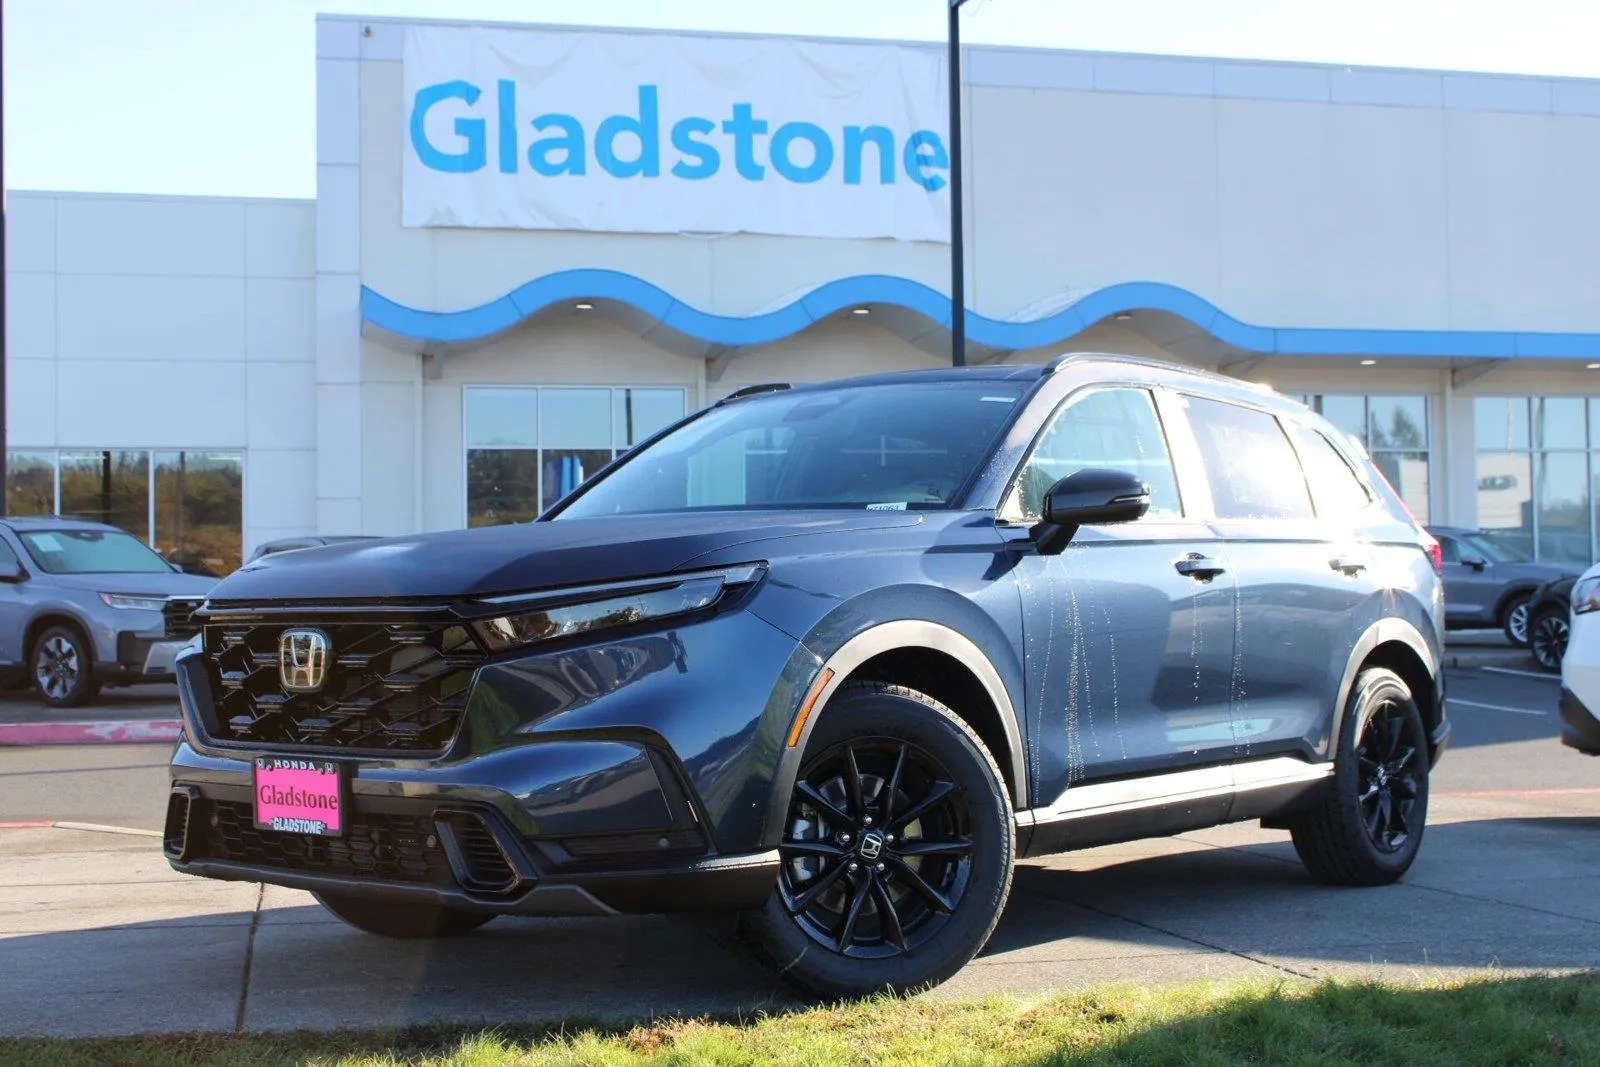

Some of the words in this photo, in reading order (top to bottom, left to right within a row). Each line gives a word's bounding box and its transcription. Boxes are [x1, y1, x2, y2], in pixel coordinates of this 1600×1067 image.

[409, 79, 950, 192] Gladstone
[274, 759, 316, 771] HONDA
[260, 785, 338, 810] Gladstone
[273, 817, 321, 835] GLADSTONE
